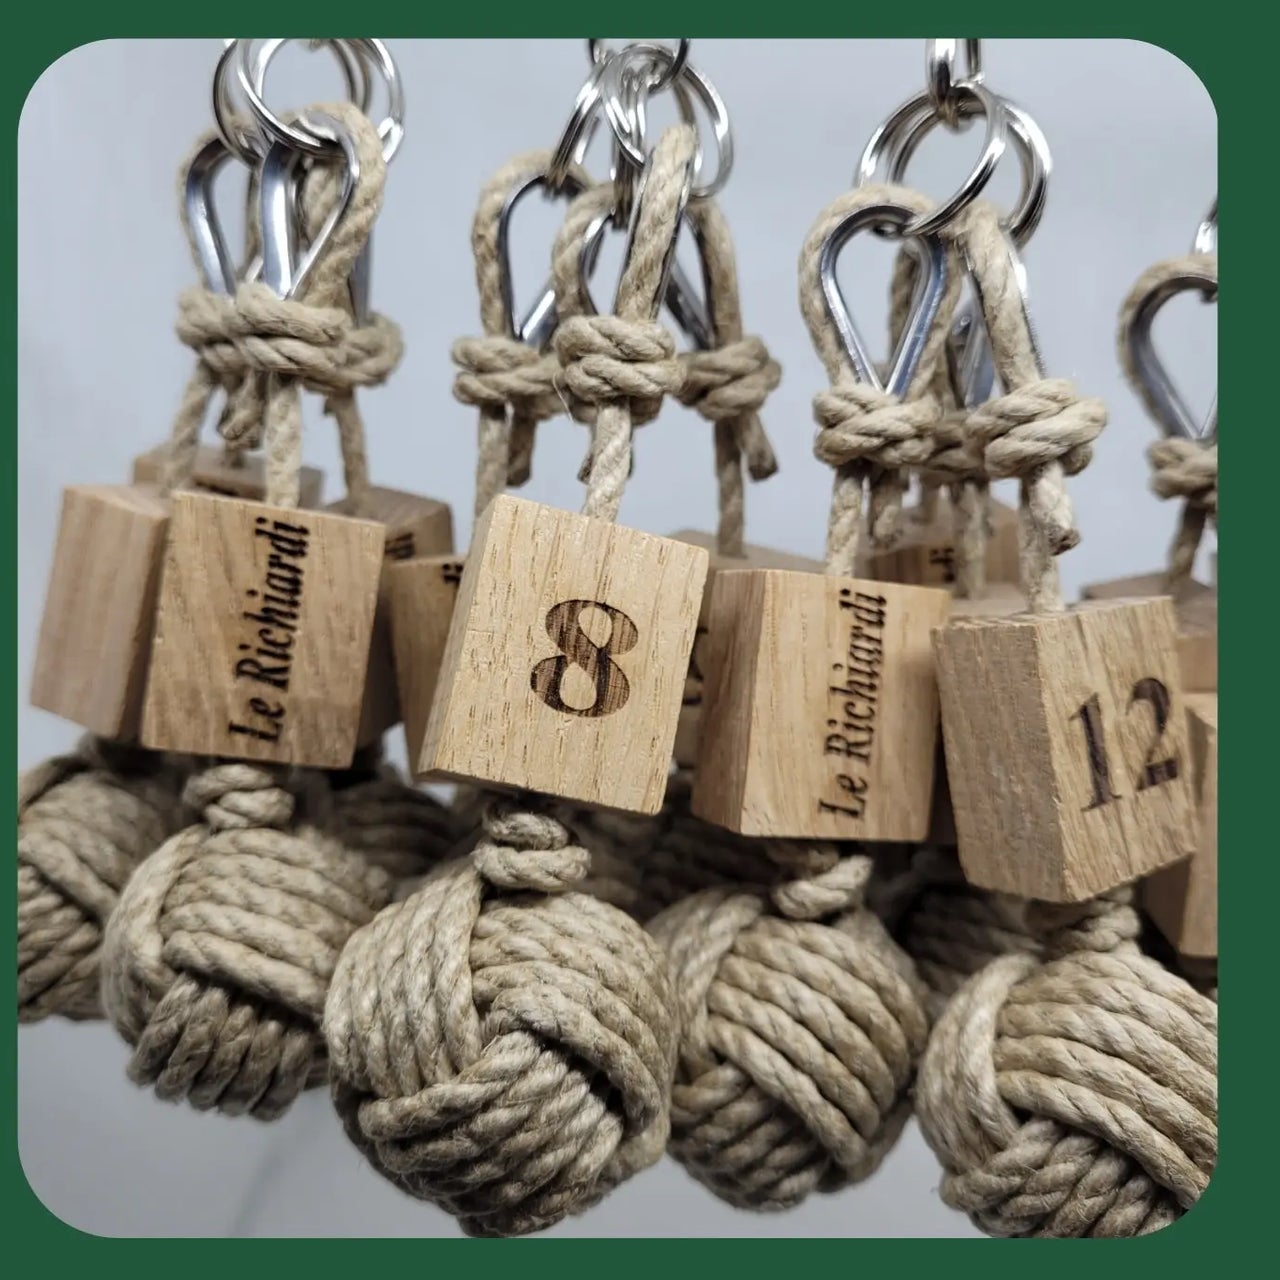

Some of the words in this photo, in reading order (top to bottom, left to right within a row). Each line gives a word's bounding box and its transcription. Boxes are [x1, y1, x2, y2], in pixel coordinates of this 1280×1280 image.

[233, 516, 311, 693] Richiardi
[529, 599, 638, 717] 8
[228, 694, 285, 745] Le
[823, 587, 888, 768] Richiardi
[817, 771, 868, 823] Le
[1068, 676, 1180, 814] 12
